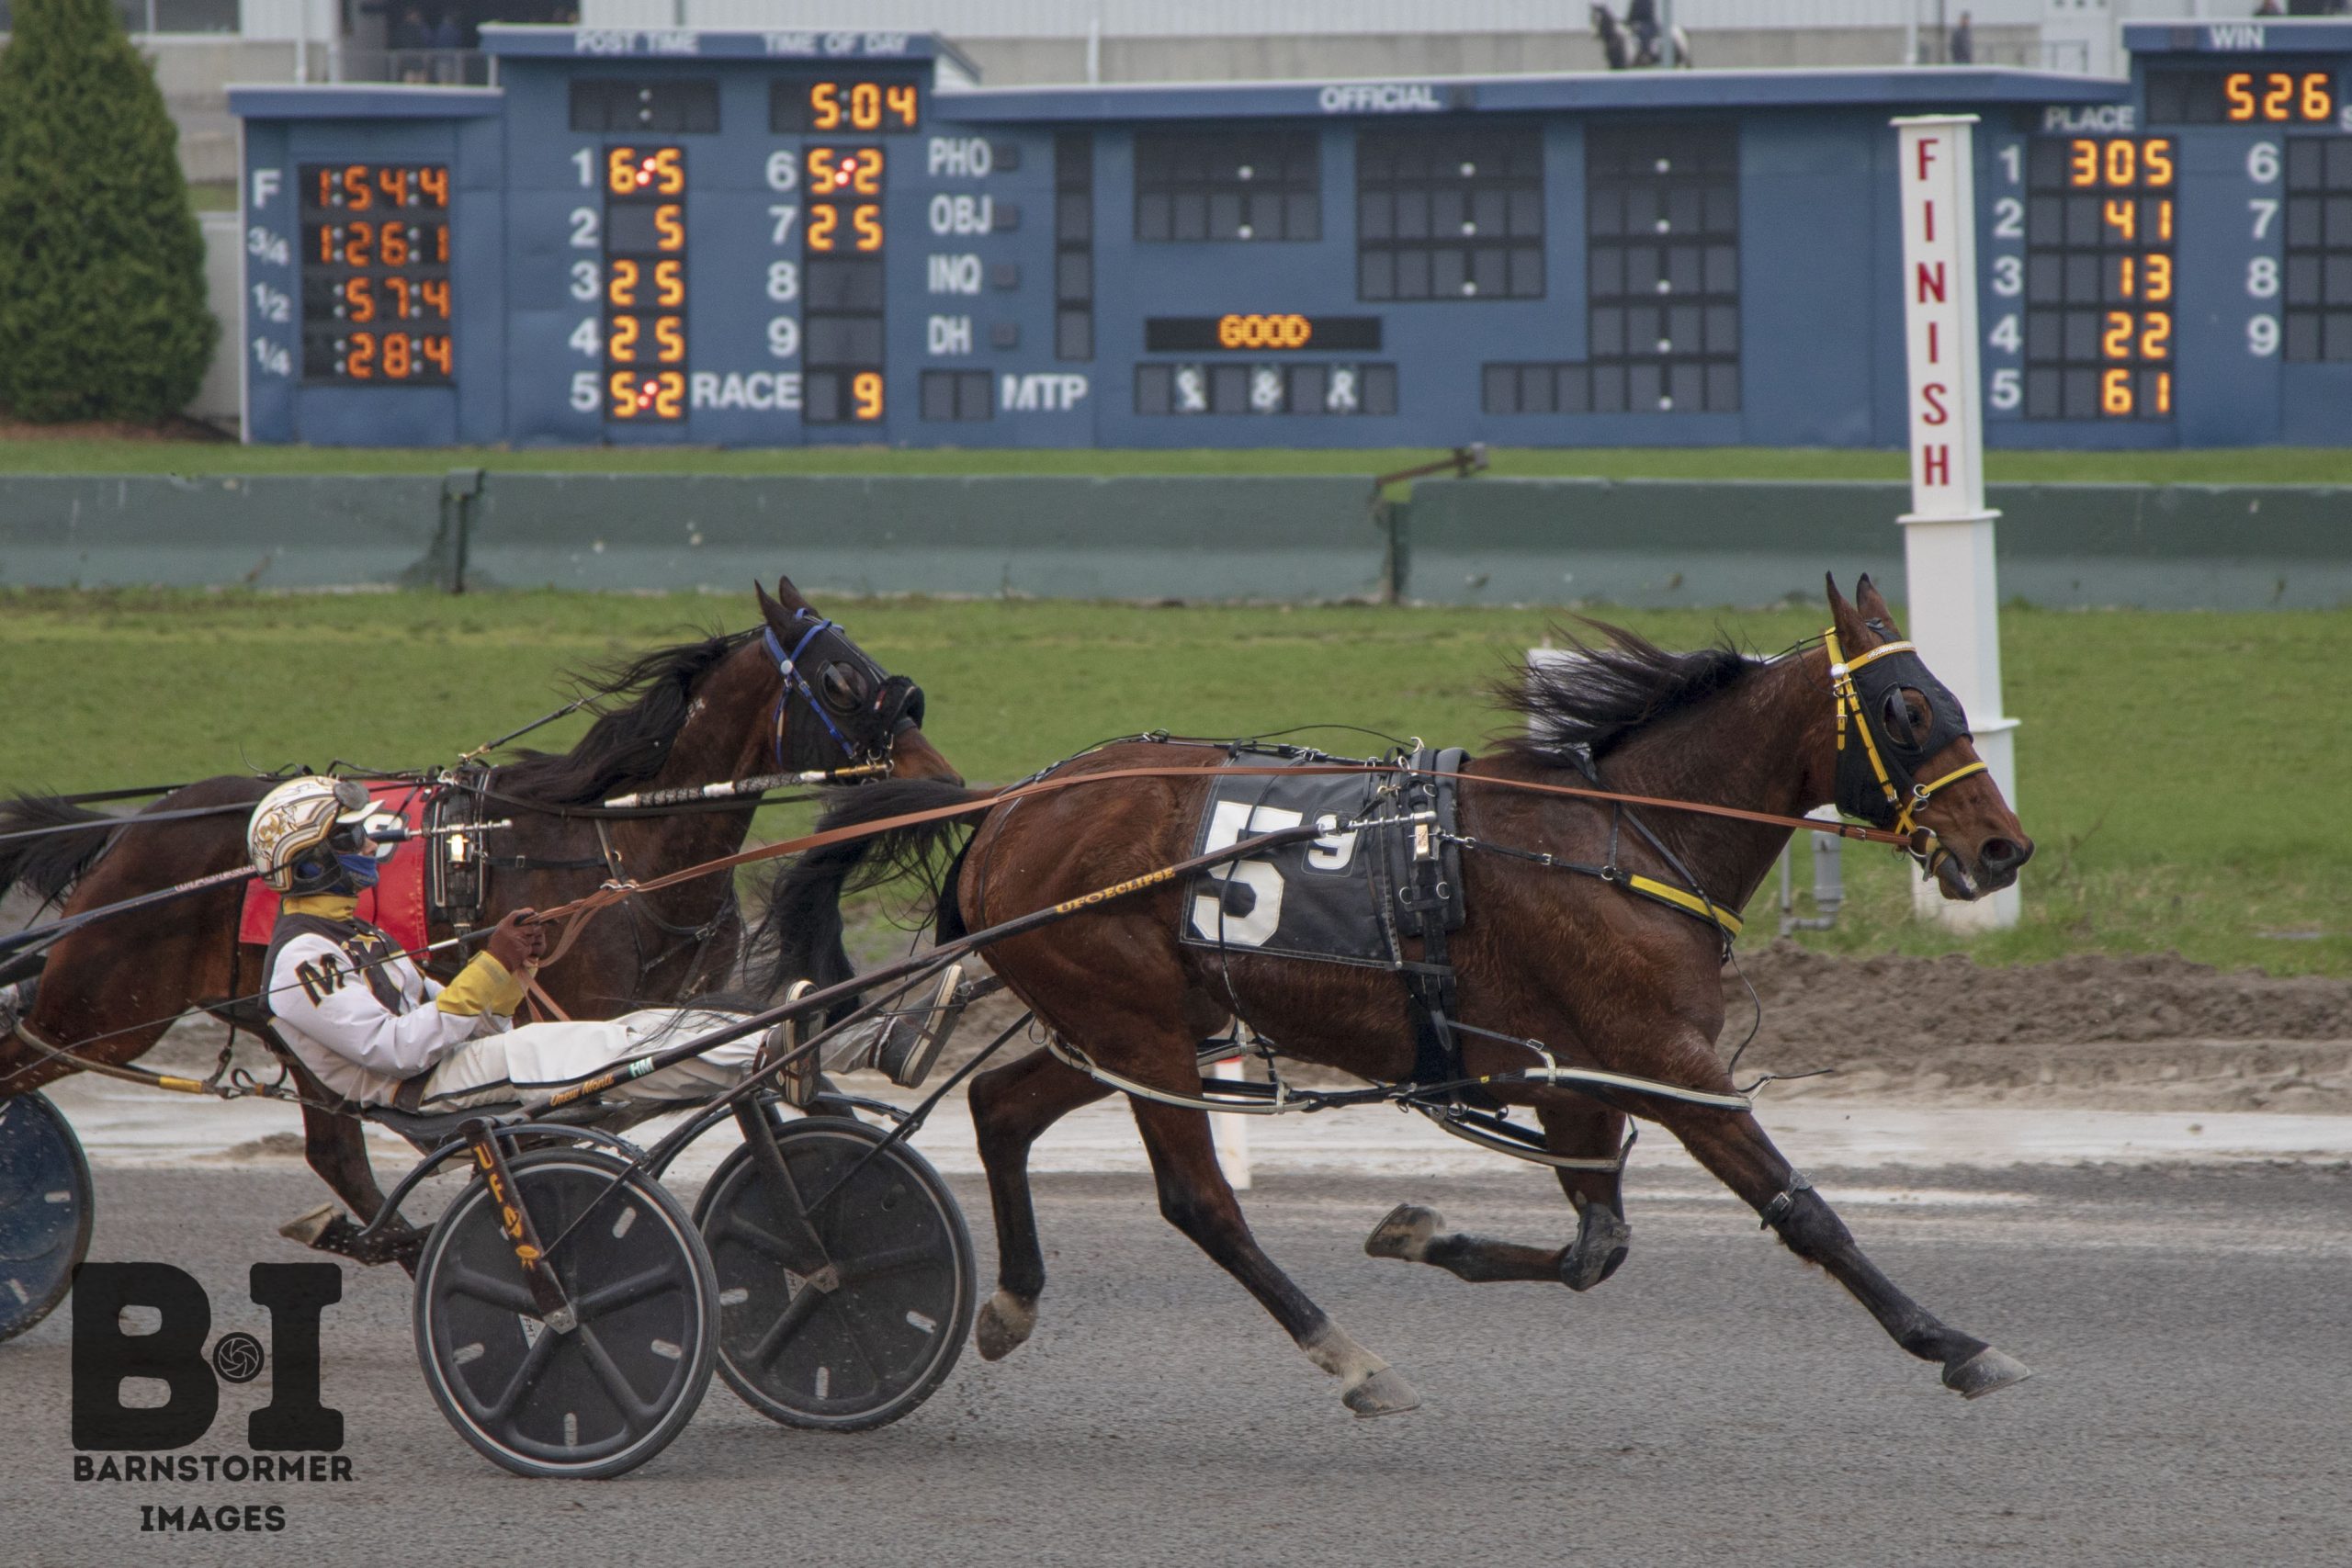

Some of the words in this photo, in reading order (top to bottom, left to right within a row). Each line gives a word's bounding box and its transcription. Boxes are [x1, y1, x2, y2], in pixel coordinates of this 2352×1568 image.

[574, 33, 637, 53] POST
[643, 33, 700, 53] TIME
[763, 34, 816, 53] TIME
[825, 34, 856, 54] OF
[863, 34, 909, 54] DAY
[2210, 26, 2264, 49] WIN
[1319, 85, 1440, 112] OFFICIAL
[2224, 73, 2332, 121] 526
[2045, 106, 2135, 133] PLACE
[572, 149, 594, 186] 1
[766, 151, 797, 191] 6
[929, 138, 990, 177] PHO
[1999, 145, 2020, 184] 1
[2072, 139, 2173, 186] 305
[2247, 142, 2279, 184] 6
[253, 170, 280, 209] F
[570, 207, 599, 247] 2
[654, 204, 684, 250] 5
[769, 205, 797, 244] 7
[930, 195, 991, 234] OBJ
[1994, 197, 2023, 239] 2
[2104, 199, 2173, 241] 41
[2248, 198, 2278, 240] 7
[571, 260, 601, 301] 3
[767, 261, 798, 301] 8
[929, 254, 982, 295] INQ
[1994, 255, 2022, 297] 3
[2120, 254, 2172, 301] 13
[2247, 256, 2278, 299] 8
[1917, 139, 1950, 487] FINISH
[569, 318, 601, 356] 4
[767, 316, 799, 357] 9
[929, 316, 971, 355] DH
[1989, 314, 2021, 354] 4
[2103, 311, 2172, 359] 22
[2247, 314, 2279, 356] 9
[571, 371, 602, 412] 5
[692, 372, 800, 410] RACE
[854, 372, 883, 419] 9
[1002, 375, 1088, 410] MTP
[1990, 368, 2021, 410] 5
[2102, 368, 2171, 415] 61
[1193, 800, 1303, 947] 5
[294, 953, 346, 1009] M
